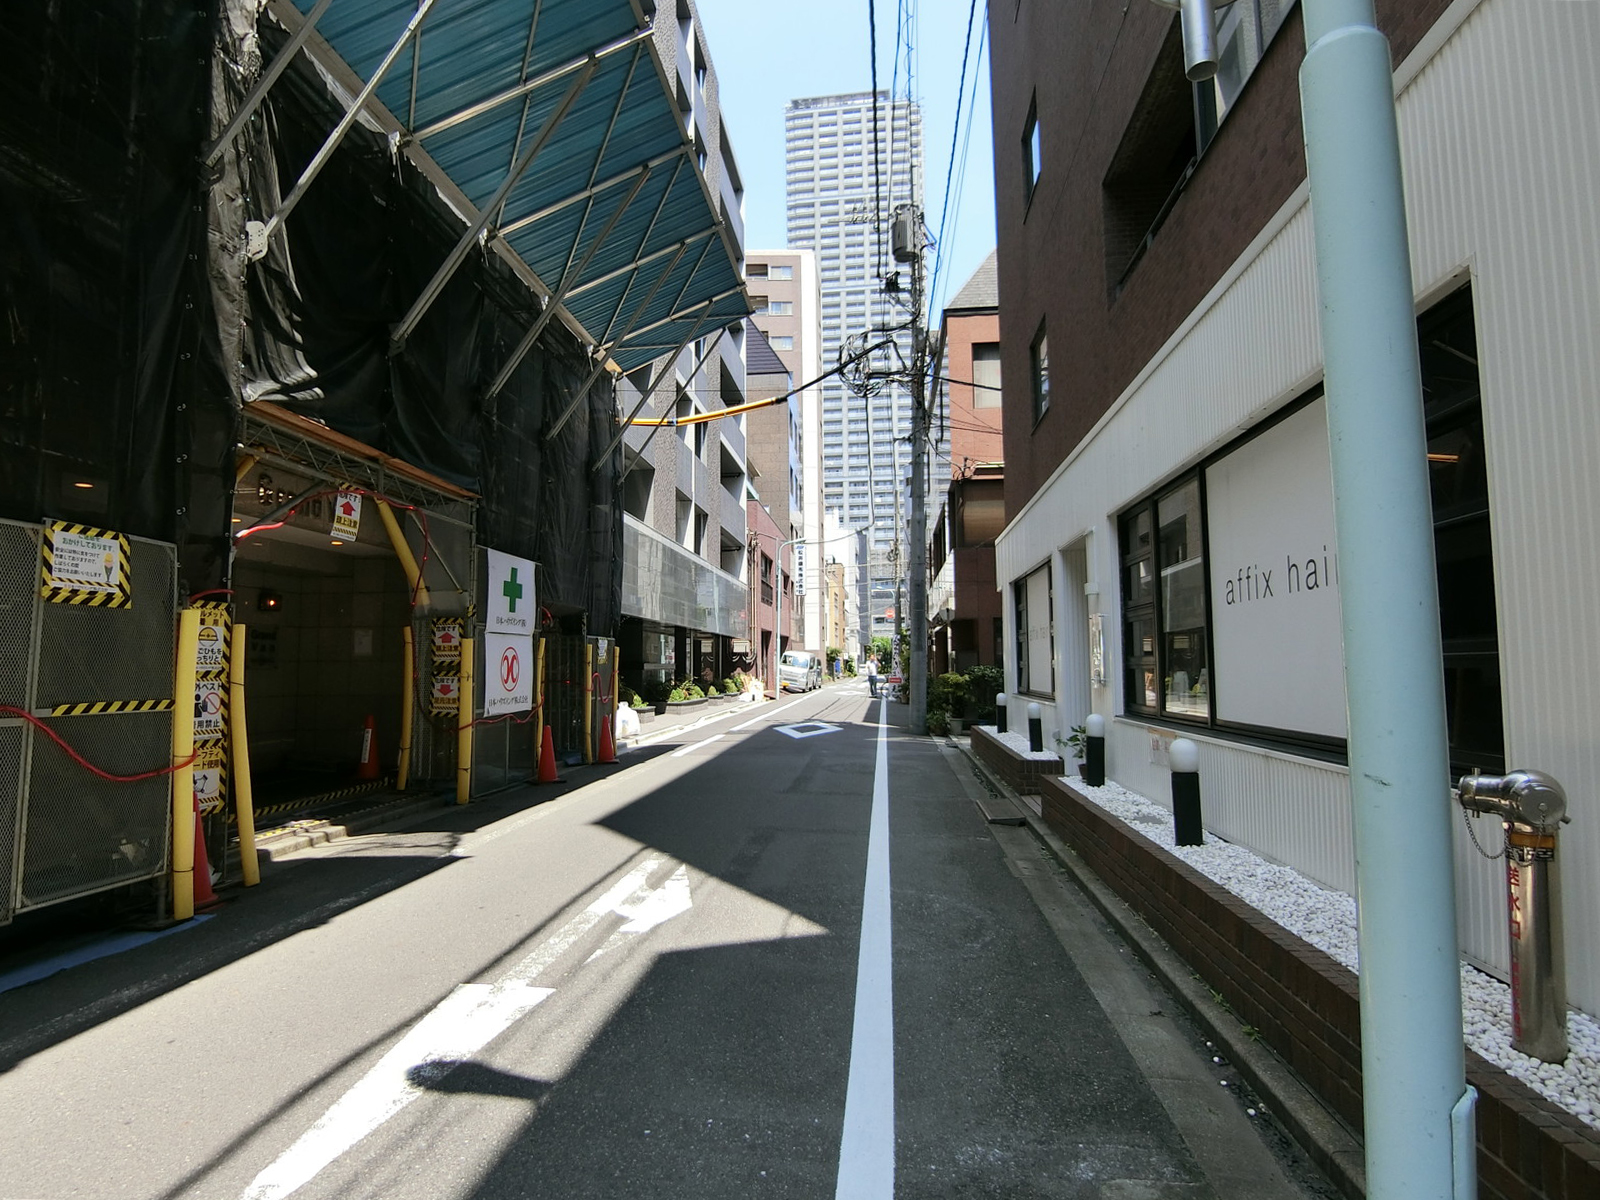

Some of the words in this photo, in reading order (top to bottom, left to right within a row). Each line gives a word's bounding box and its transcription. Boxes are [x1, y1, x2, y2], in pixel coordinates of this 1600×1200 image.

[62, 537, 115, 552] おかけしております。
[1226, 564, 1274, 605] affix
[200, 610, 224, 619] ルメット
[197, 648, 222, 656] ごひもを
[196, 654, 220, 663] っちりと
[193, 758, 219, 769] ード使用
